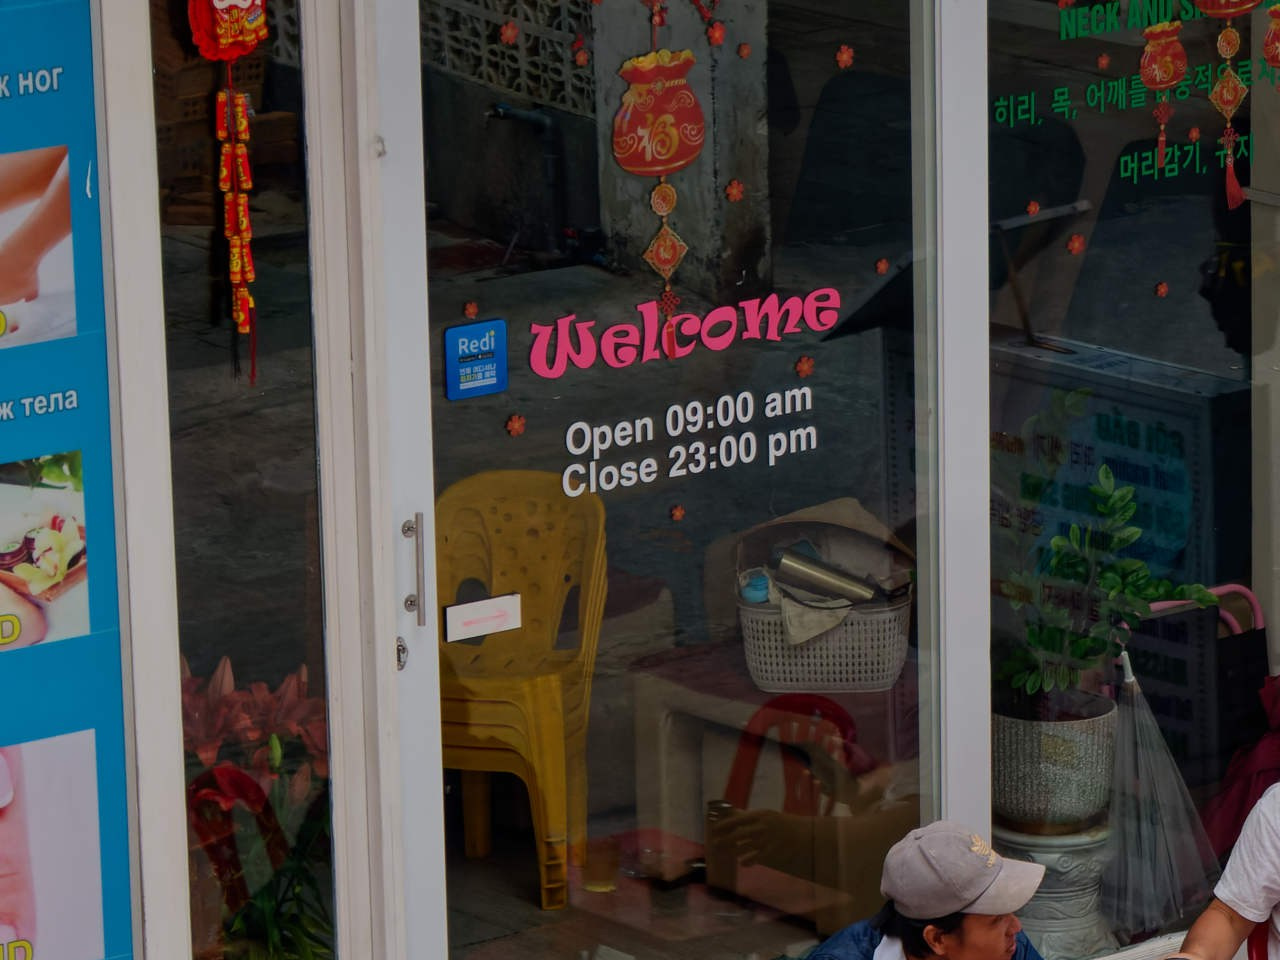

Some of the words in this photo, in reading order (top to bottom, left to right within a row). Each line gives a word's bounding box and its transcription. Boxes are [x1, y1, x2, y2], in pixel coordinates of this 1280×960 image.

[1060, 3, 1121, 40] NECK
[18, 67, 63, 95] ног
[458, 329, 495, 354] Redi
[529, 287, 841, 379] Welcome
[21, 390, 79, 417] тела
[566, 417, 653, 460] Open
[666, 391, 754, 438] 09:00
[765, 386, 812, 418] am
[562, 457, 658, 498] Close
[668, 431, 757, 478] 23:00
[768, 425, 816, 466] pm
